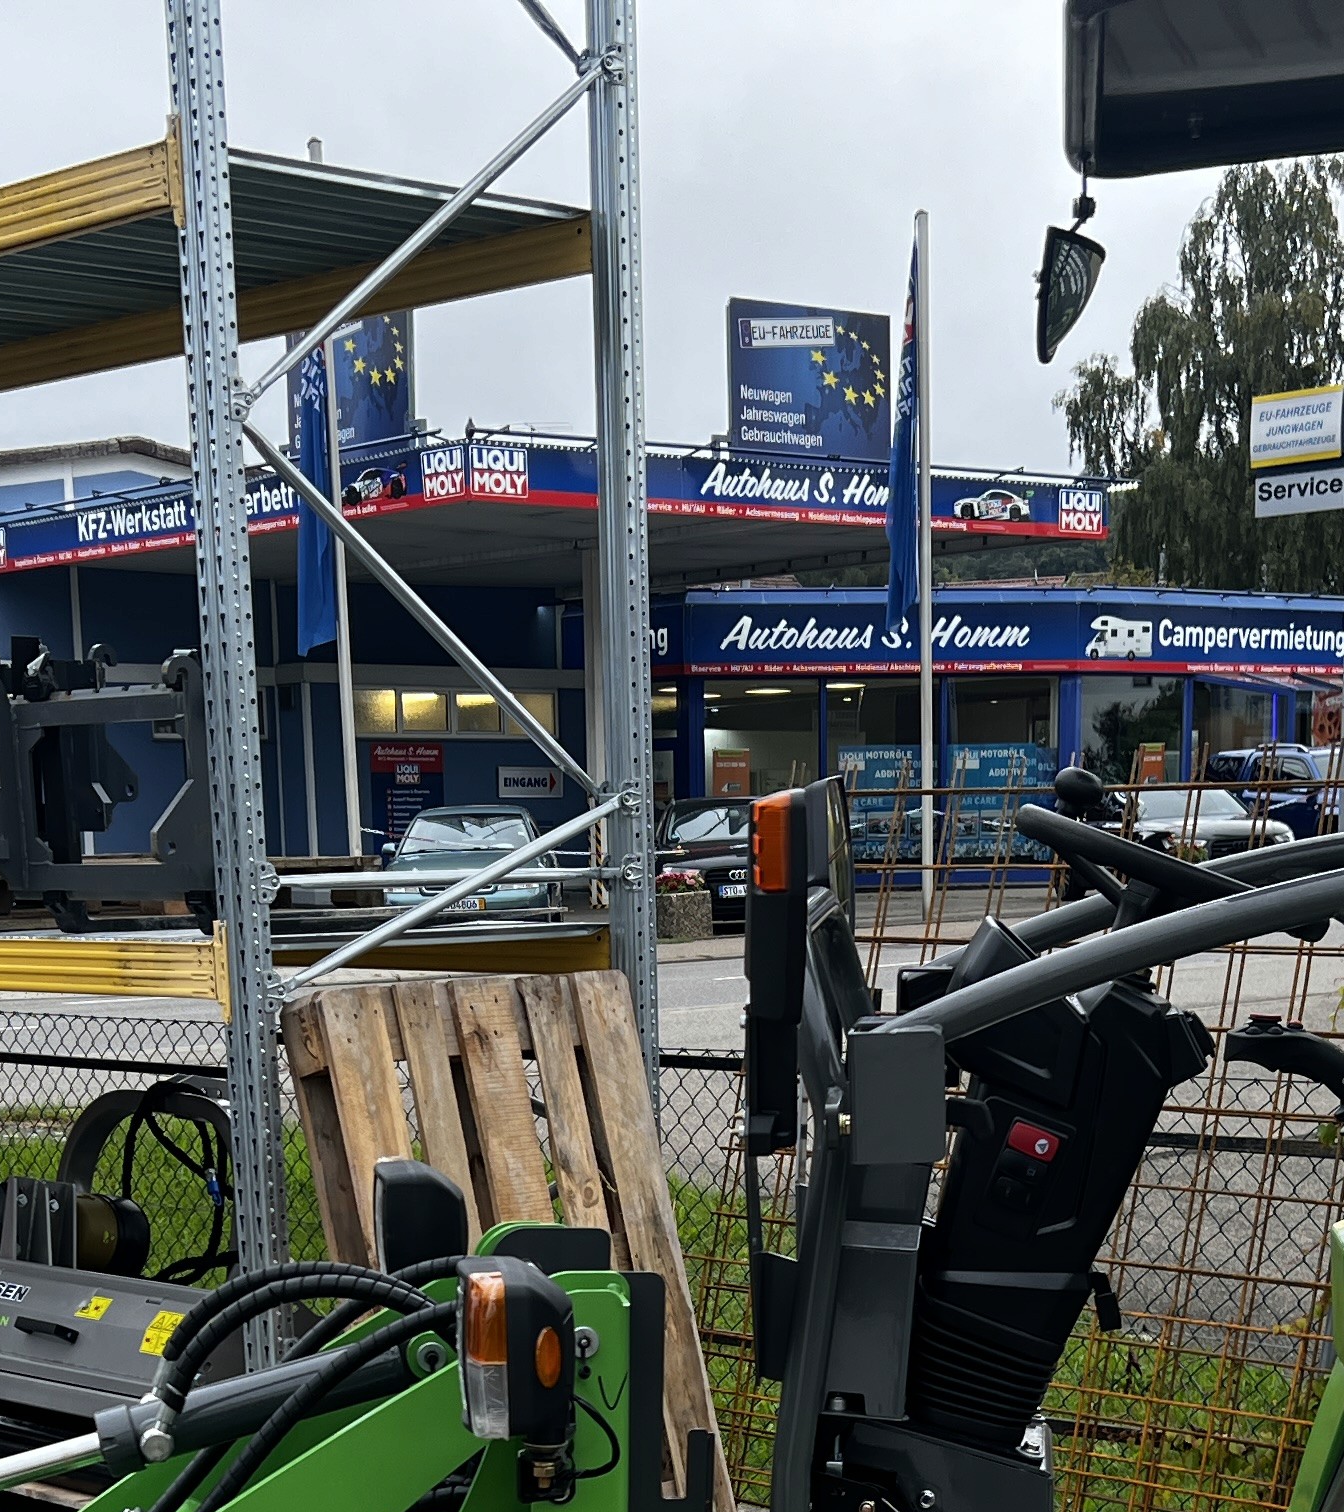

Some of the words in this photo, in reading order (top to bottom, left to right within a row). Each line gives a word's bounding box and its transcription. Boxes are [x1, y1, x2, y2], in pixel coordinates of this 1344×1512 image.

[751, 324, 832, 341] EU-FAHRZEUGE
[740, 384, 793, 405] Neuwagen
[740, 406, 806, 427] Jahreswagen
[1259, 401, 1333, 423] EU-FAHRZEUGE
[741, 426, 823, 449] Gebrauchtwagen
[1266, 420, 1324, 438] JUNGWAGEN
[1253, 434, 1337, 454] GEBRAUCHTFAHRZEUGE
[423, 448, 462, 474] LIQUI
[471, 448, 526, 472] LIQUI
[424, 471, 463, 498] MOLY
[472, 473, 527, 495] MOLY
[701, 462, 809, 502] Autohaus
[813, 471, 836, 504] S.
[1258, 475, 1344, 502] Service
[1061, 492, 1100, 511] LIQUI
[77, 498, 187, 542] KFZ-Werkstatt
[1060, 512, 1101, 531] MOLY
[719, 614, 874, 652] Autohaus
[930, 615, 1031, 650] Homm
[1158, 618, 1344, 657] Campervermietung
[865, 749, 913, 760] MOTORÖLE
[980, 747, 1025, 758] MOTORÖLE
[396, 764, 419, 774] LIQUI
[396, 774, 420, 784] MOLY
[504, 776, 548, 788] EINGANG
